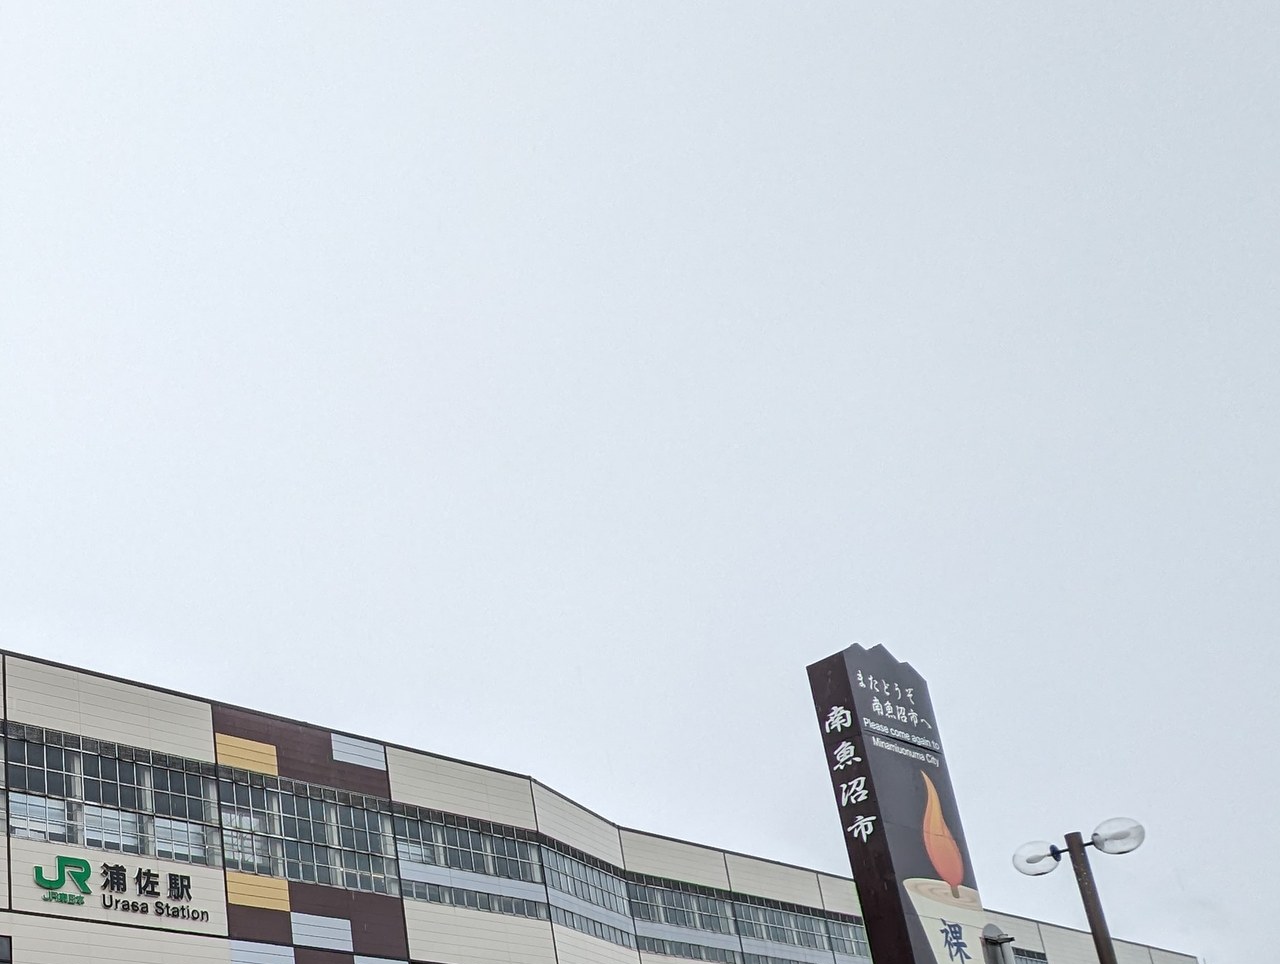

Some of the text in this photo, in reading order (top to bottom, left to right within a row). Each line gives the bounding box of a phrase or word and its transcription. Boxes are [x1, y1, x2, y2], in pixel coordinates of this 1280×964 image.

[863, 717, 940, 750] Please come again to
[872, 736, 940, 767] Minamiuonuma City
[825, 705, 877, 843] 南魚沼市
[33, 855, 92, 894] JR
[100, 862, 192, 901] 浦佐駅
[102, 893, 209, 922] Urasa Station
